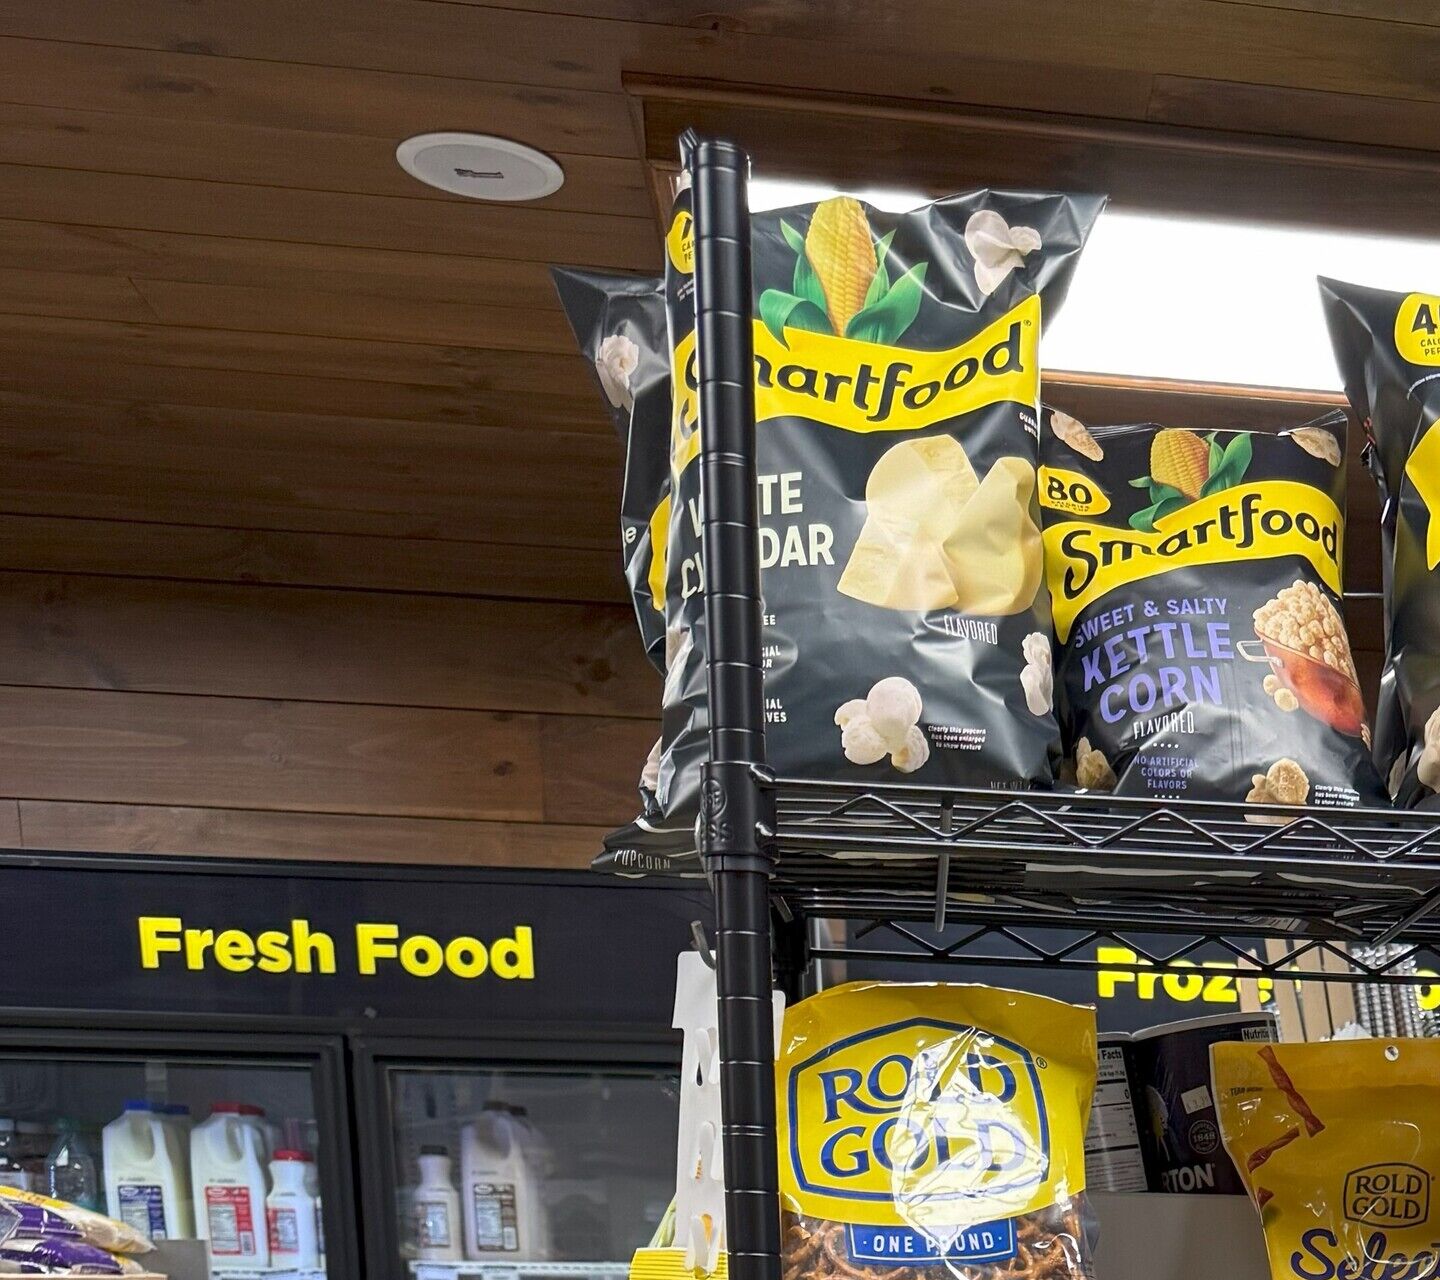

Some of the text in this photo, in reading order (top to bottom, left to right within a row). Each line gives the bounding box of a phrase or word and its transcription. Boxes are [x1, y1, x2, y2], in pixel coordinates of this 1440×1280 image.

[1047, 476, 1093, 504] 80
[1061, 493, 1339, 599] Smartfood
[943, 614, 998, 646] FLAVORED
[1075, 598, 1227, 649] SWEET & SALTY
[1081, 622, 1235, 692] KETTLE
[1099, 666, 1223, 724] CORN
[1133, 711, 1195, 739] FLAVORED
[1141, 767, 1177, 779] COLORS
[1149, 757, 1199, 769] ARTIFICIAL
[1147, 778, 1188, 790] FLAVORS
[138, 916, 535, 980] Fresh Food
[818, 1118, 1028, 1179] GOLD
[1354, 1173, 1422, 1195] ROLD
[1352, 1196, 1421, 1220] GOLD
[873, 1231, 997, 1256] ONE POUND
